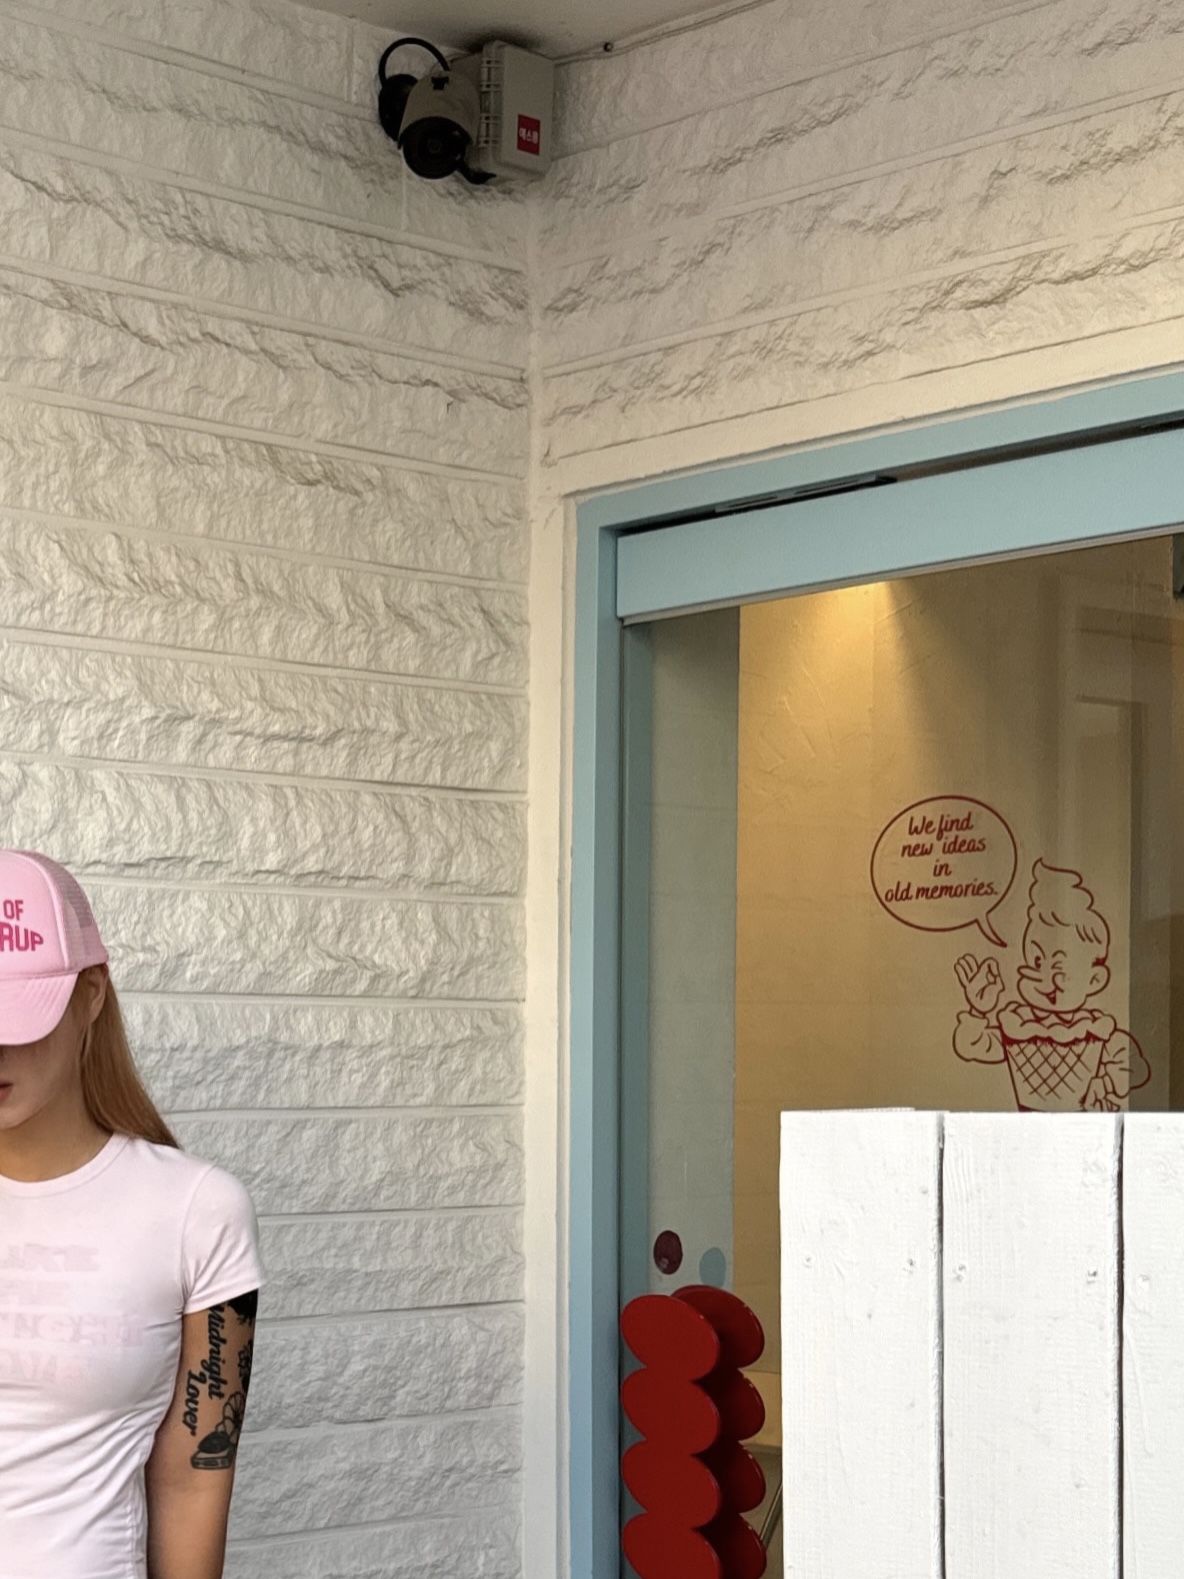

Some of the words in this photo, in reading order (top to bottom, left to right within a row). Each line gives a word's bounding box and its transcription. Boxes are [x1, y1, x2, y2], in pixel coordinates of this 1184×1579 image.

[908, 816, 936, 836] We
[936, 811, 974, 841] find
[901, 843, 933, 858] new
[941, 835, 986, 855] ideas
[933, 859, 952, 877] in
[884, 880, 913, 902] old
[915, 878, 998, 901] memories.
[3, 899, 24, 922] OF
[182, 1369, 207, 1437] Lover
